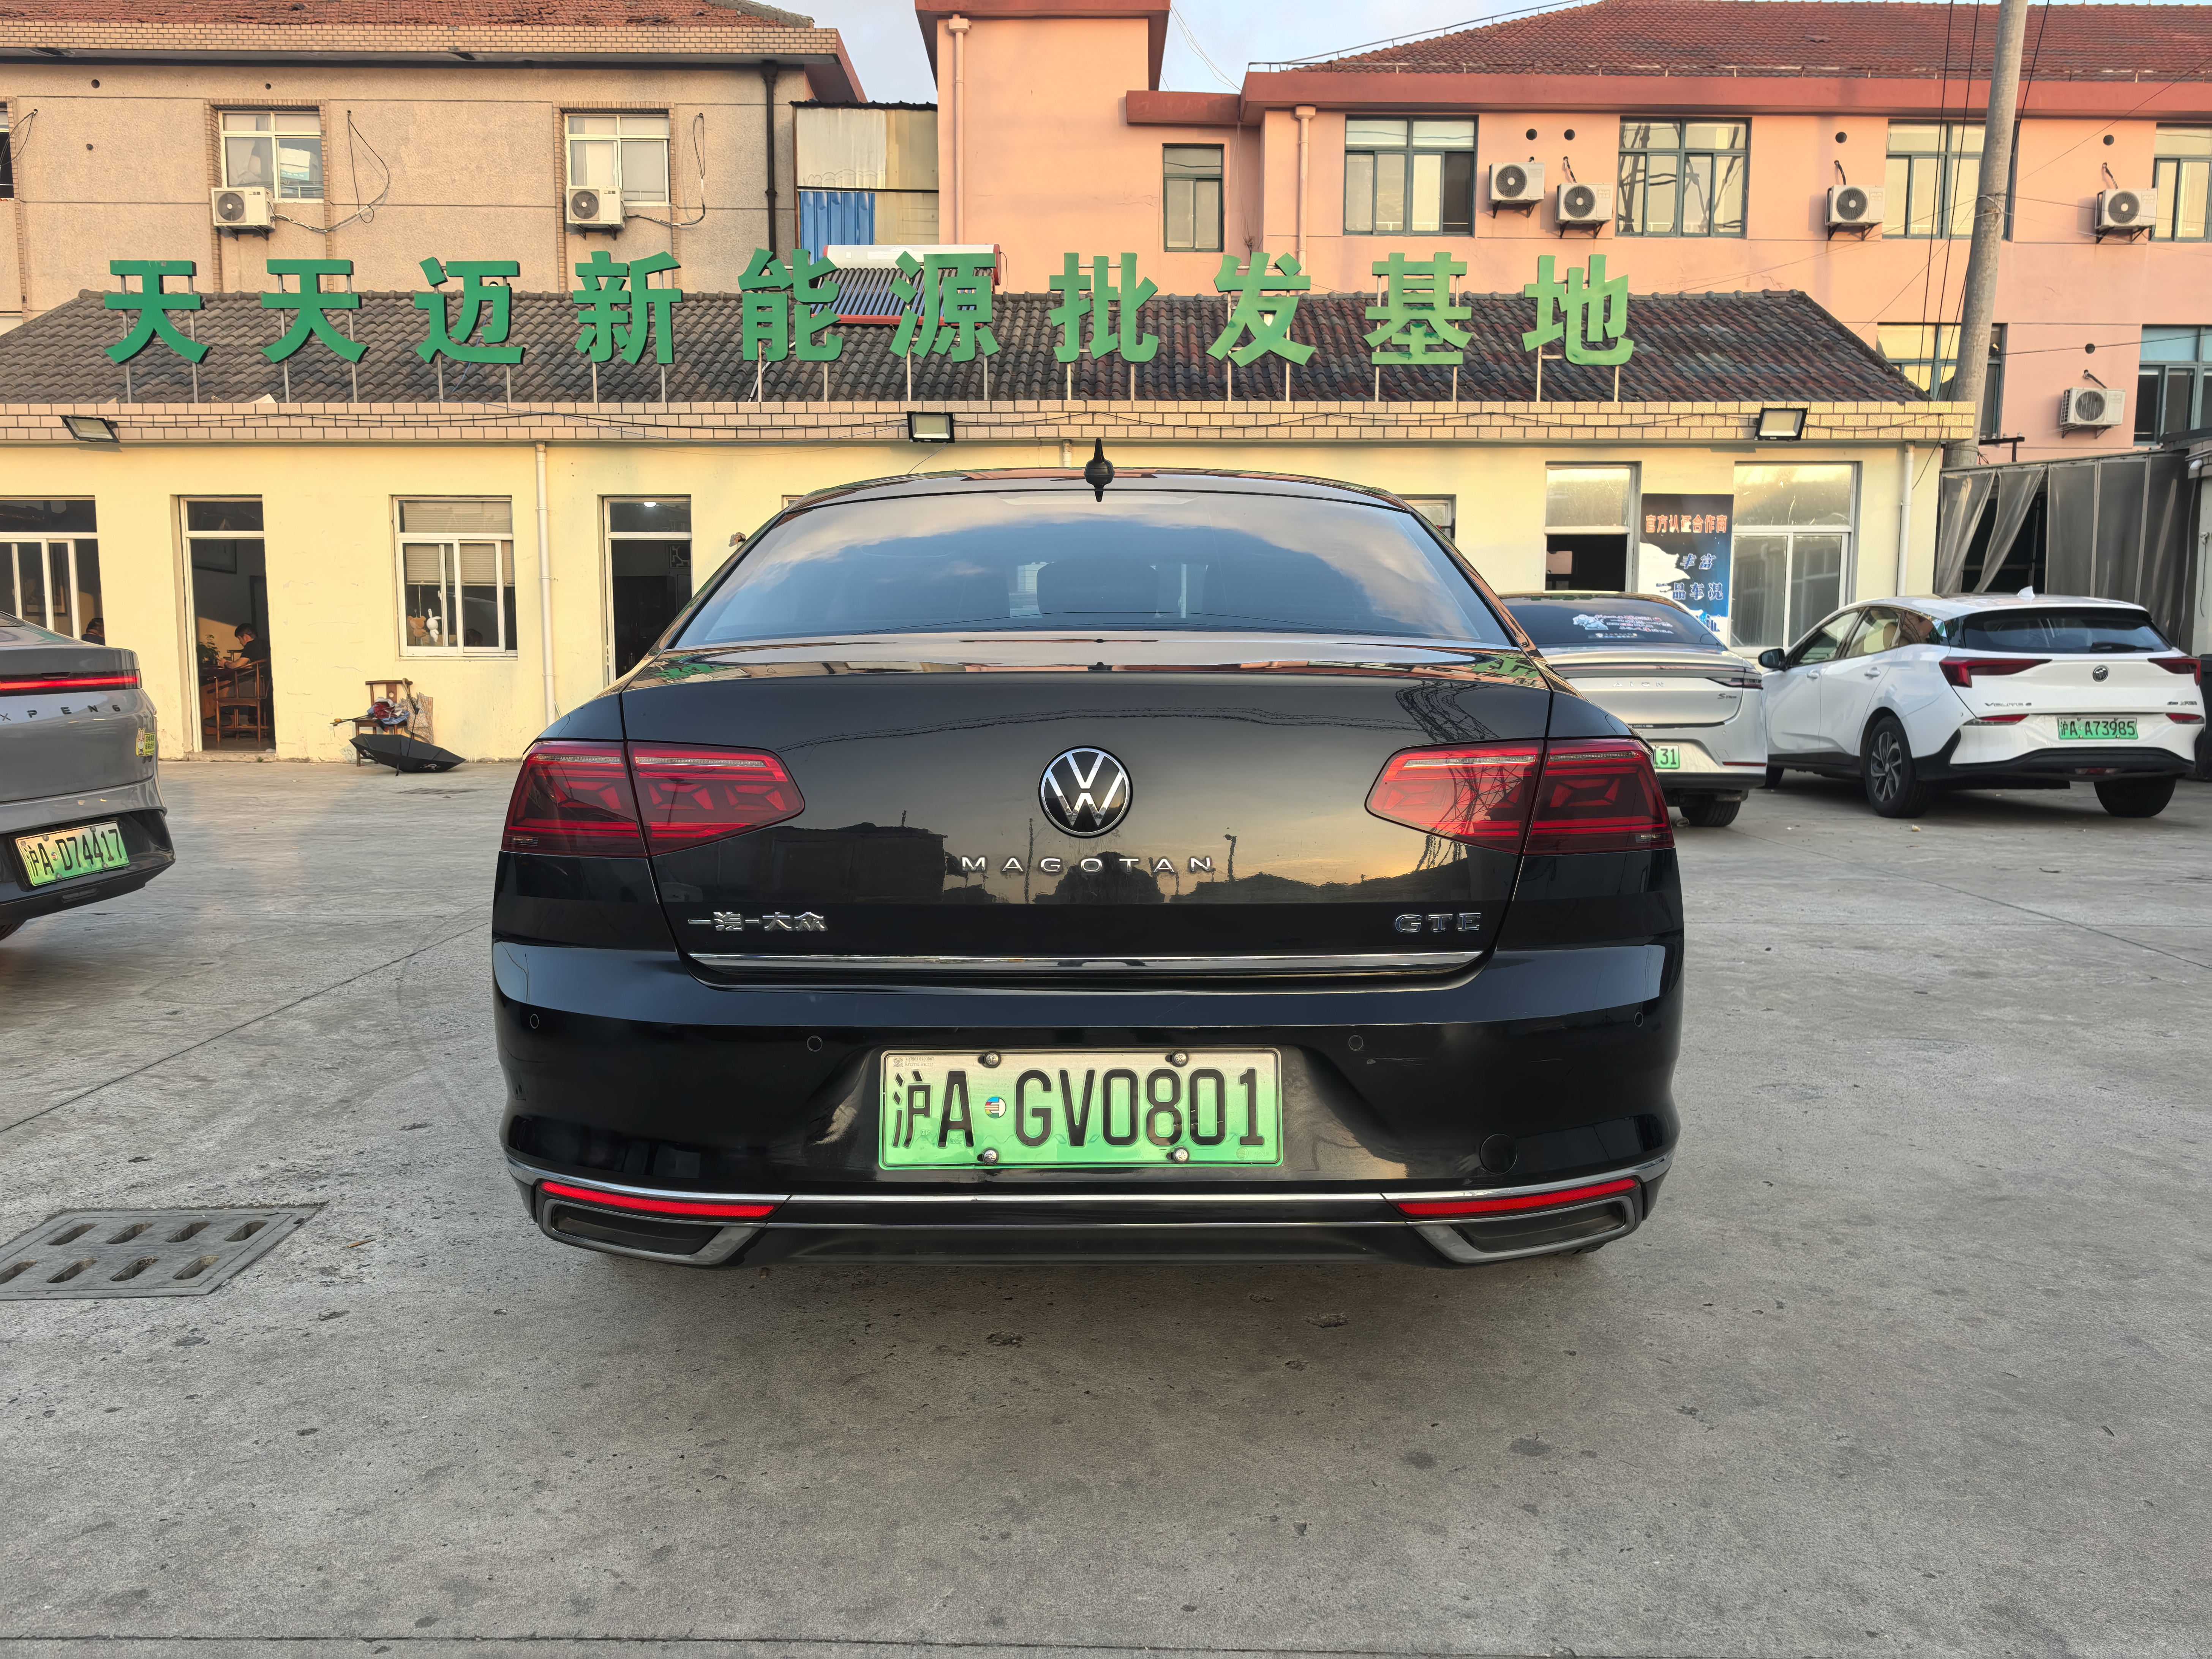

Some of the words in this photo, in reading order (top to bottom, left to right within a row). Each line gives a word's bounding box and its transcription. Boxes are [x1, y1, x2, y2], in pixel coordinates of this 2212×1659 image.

[104, 248, 1634, 368] 天天迈新能源批发基地
[1656, 582, 1724, 601] 品车况
[0, 705, 121, 721] XPENG
[2060, 720, 2078, 736] 沪A
[2085, 721, 2135, 736] A73985
[23, 842, 54, 877] 沪A
[55, 829, 122, 871] D74417
[961, 857, 1212, 873] MAGOTAN
[1395, 912, 1481, 932] GTE
[893, 1069, 974, 1148] 沪A
[1015, 1068, 1264, 1147] GV0801
